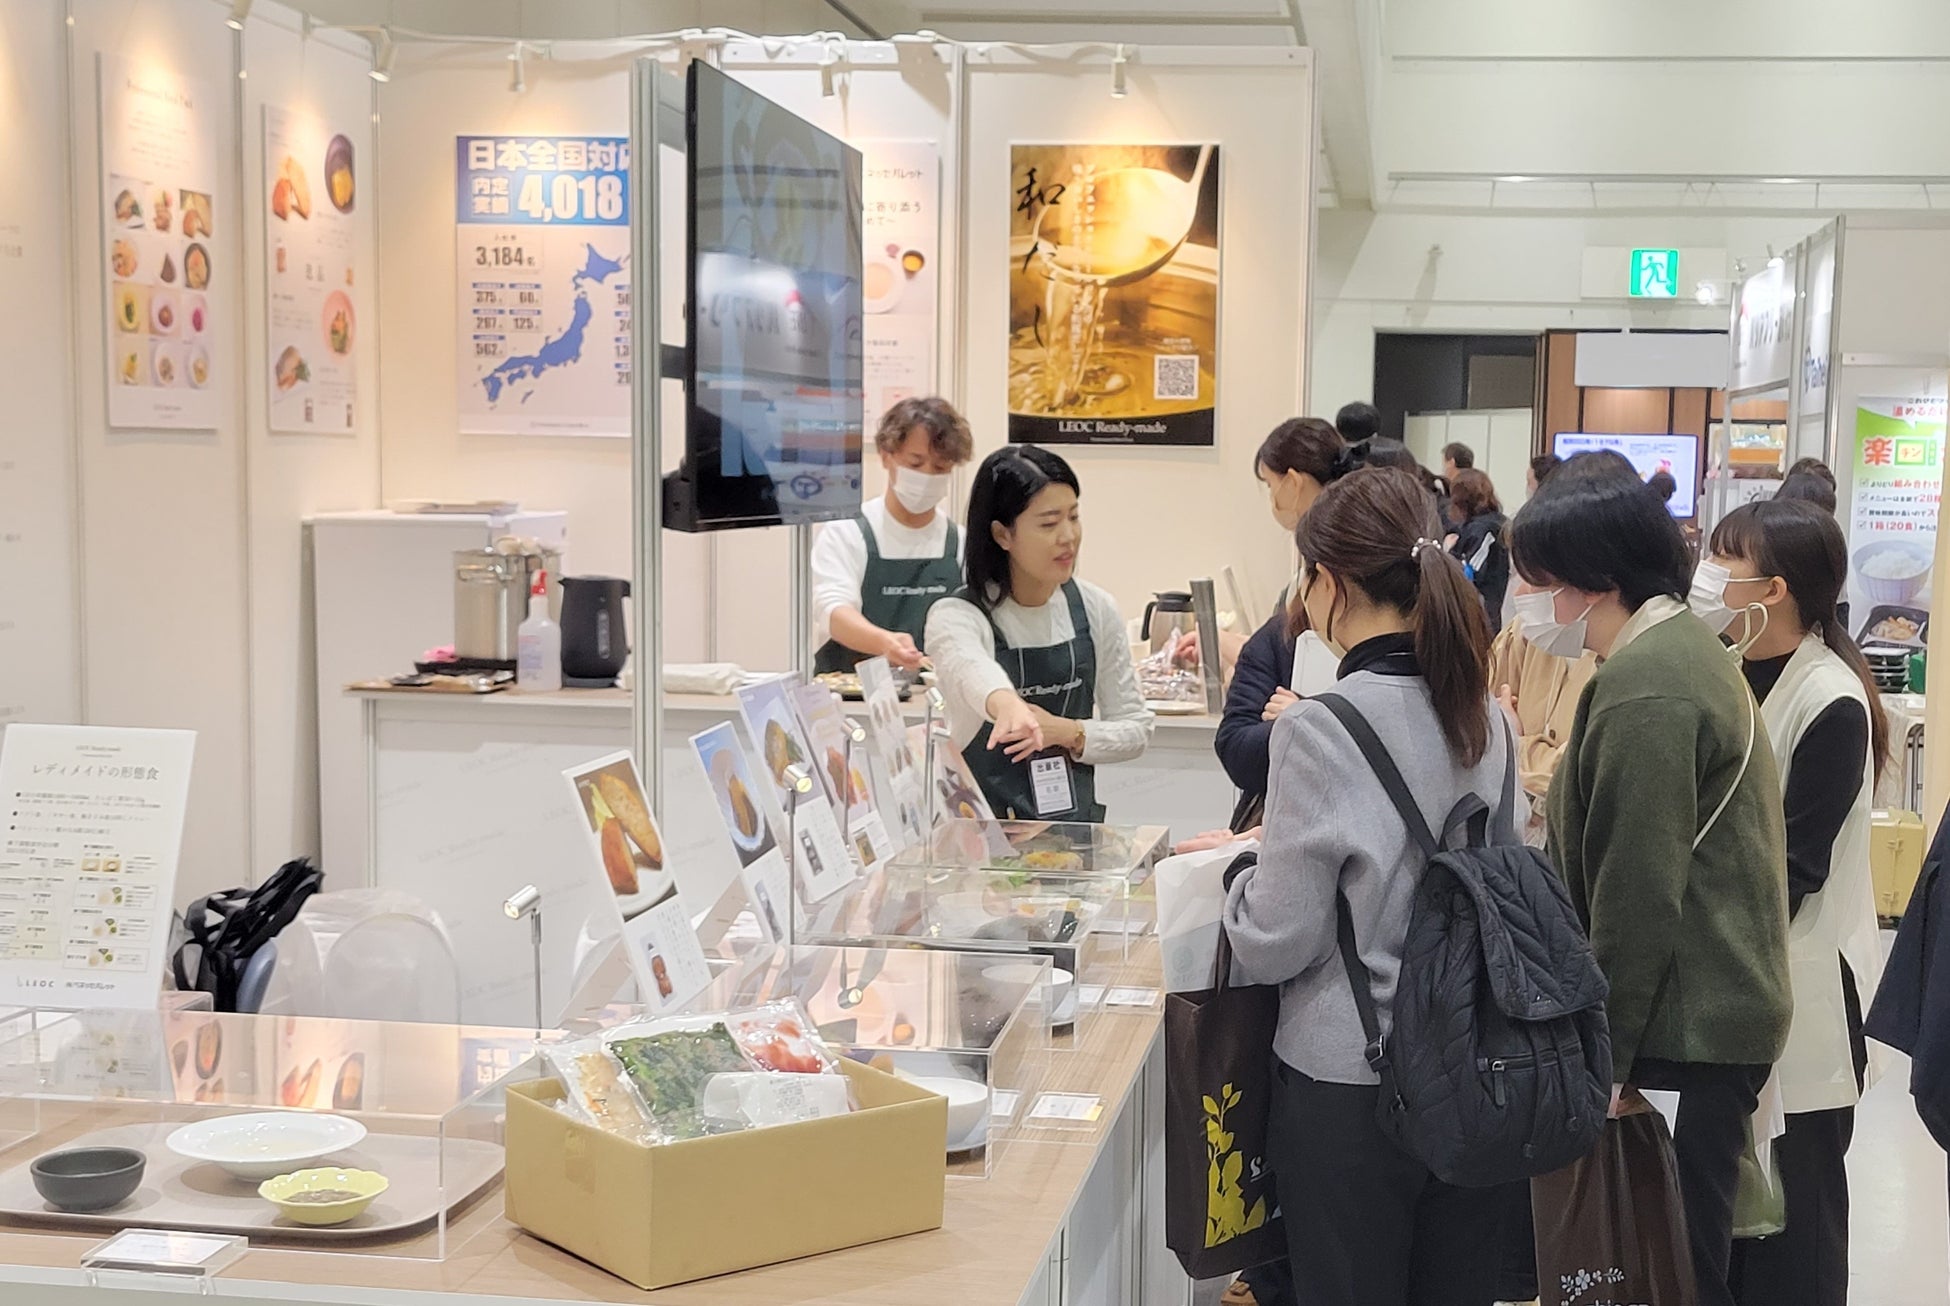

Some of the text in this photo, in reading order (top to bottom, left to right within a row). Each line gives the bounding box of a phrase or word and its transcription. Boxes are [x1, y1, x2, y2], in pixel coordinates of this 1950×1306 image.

[518, 174, 623, 222] 4,018
[475, 246, 524, 267] 3,184
[1058, 420, 1094, 433] LEOC
[1864, 437, 1893, 466] 楽
